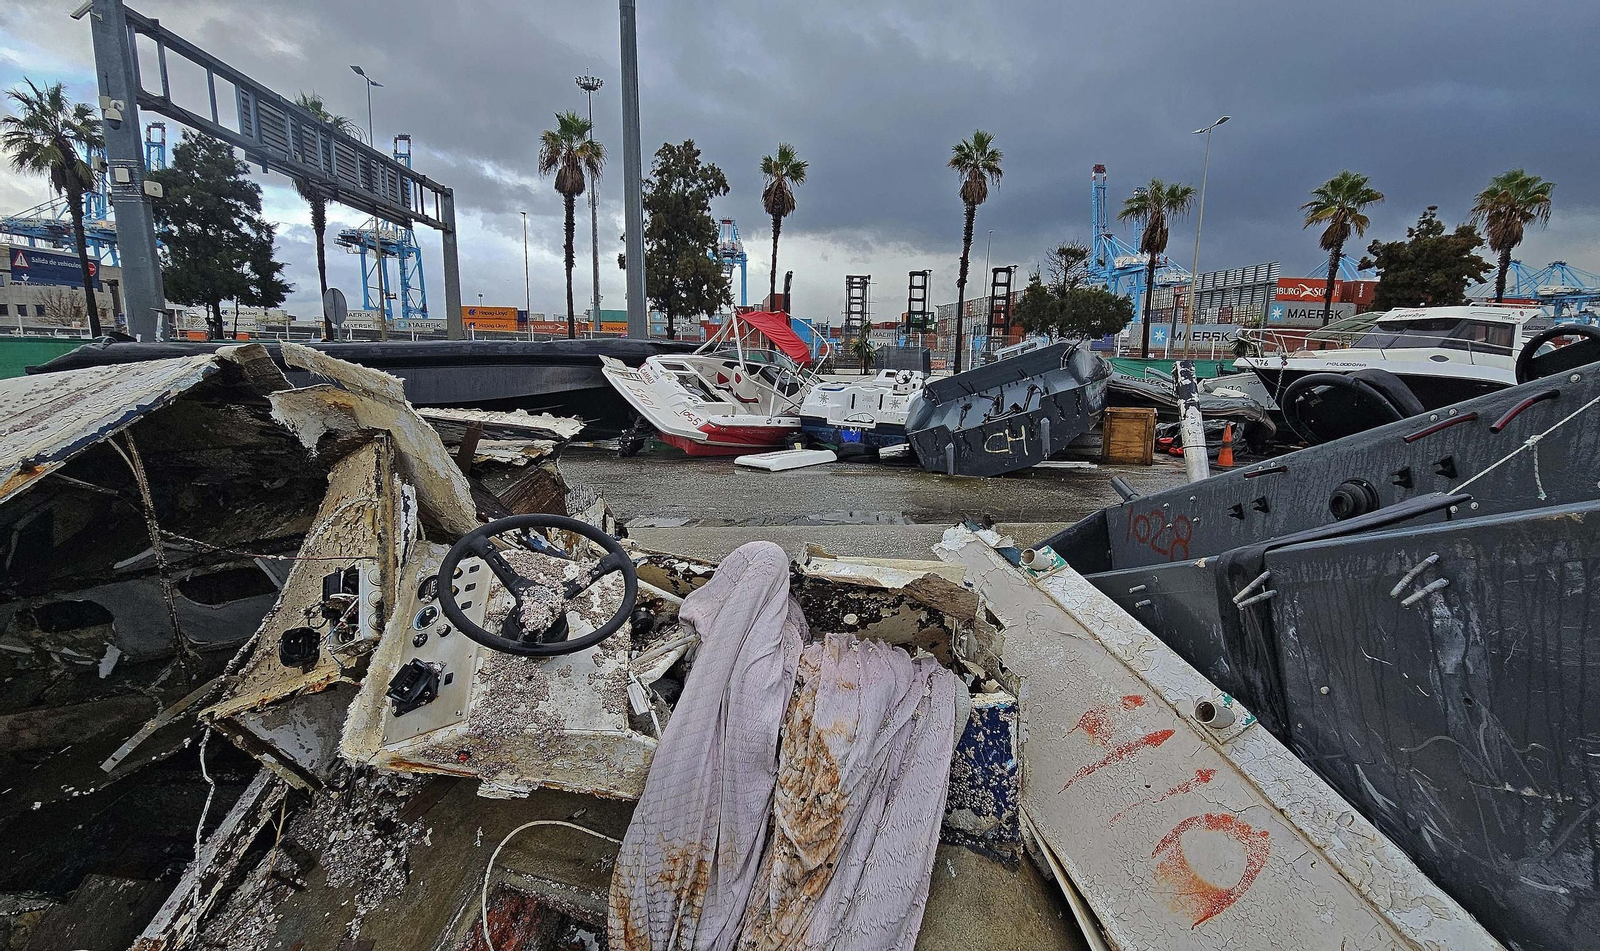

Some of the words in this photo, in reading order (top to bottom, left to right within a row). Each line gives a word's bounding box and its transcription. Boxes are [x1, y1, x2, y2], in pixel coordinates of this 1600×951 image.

[31, 256, 49, 265] Salida
[1276, 287, 1299, 295] BURG
[1125, 504, 1192, 562] 1028
